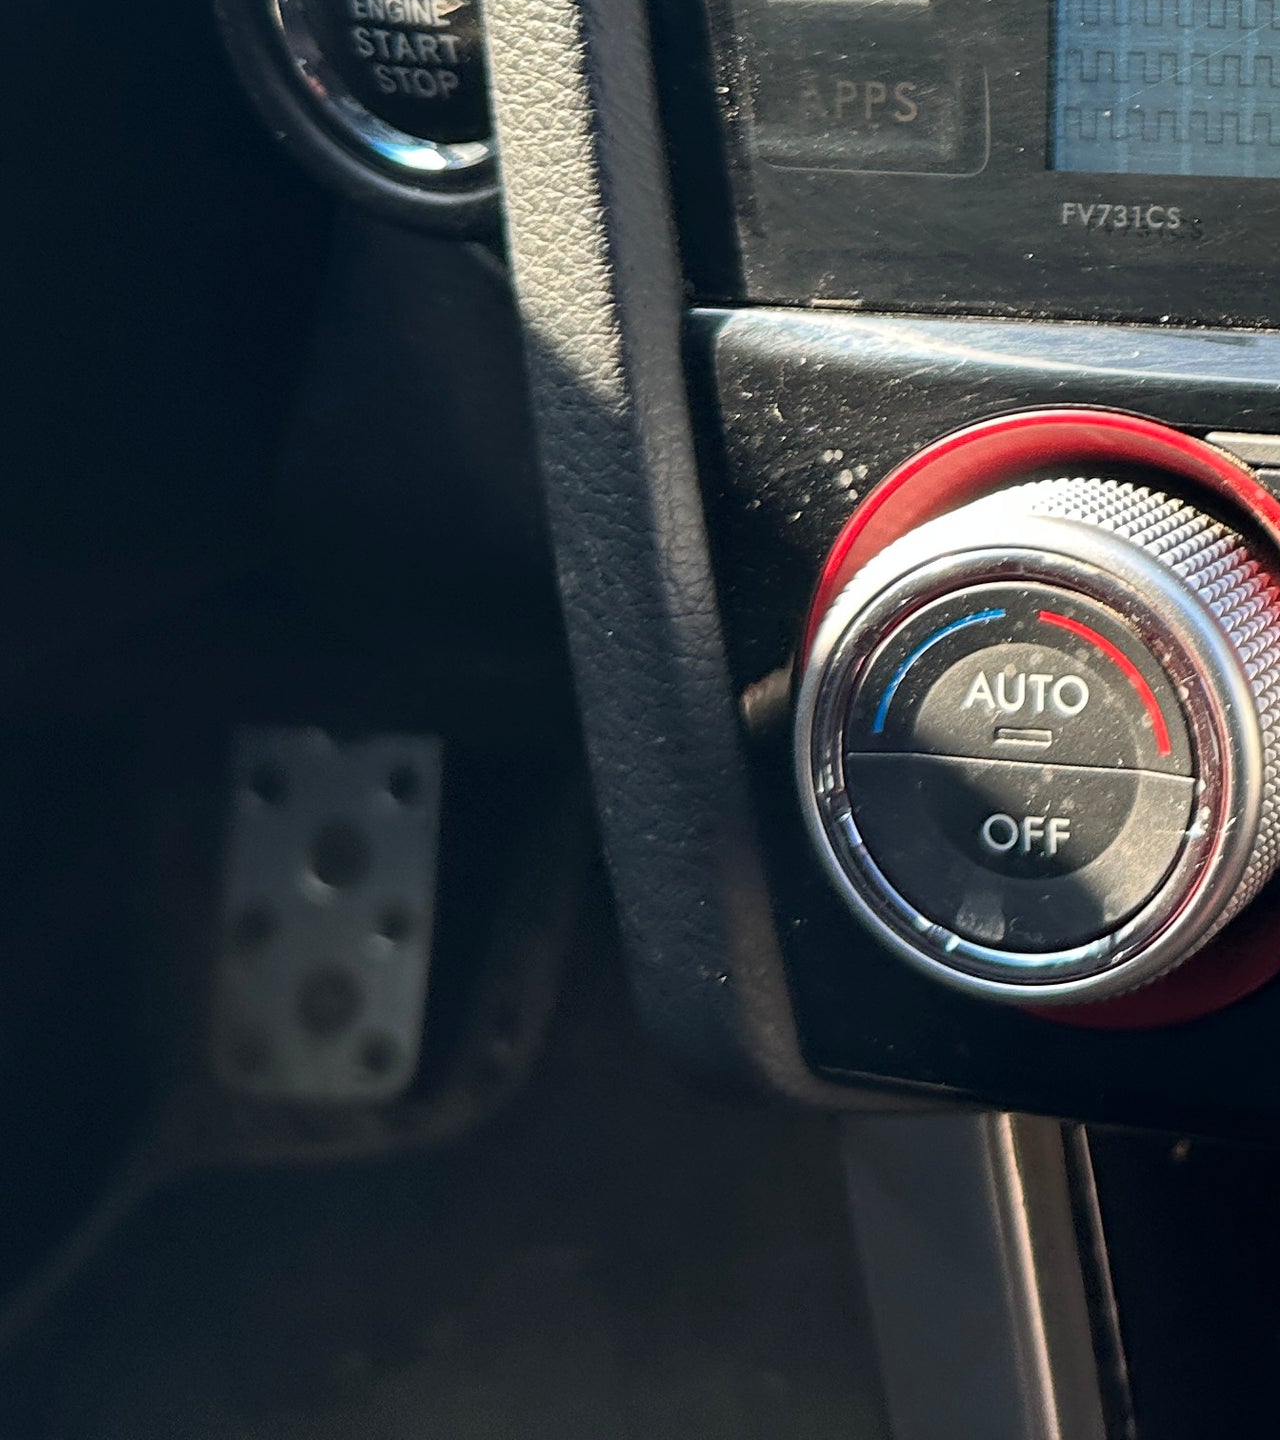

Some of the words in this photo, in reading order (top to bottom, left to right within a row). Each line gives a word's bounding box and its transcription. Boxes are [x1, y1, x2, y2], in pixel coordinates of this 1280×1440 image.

[353, 25, 460, 62] START
[374, 64, 459, 98] STOP
[1061, 203, 1183, 229] FV731CS
[962, 672, 1090, 716] AUTO
[982, 813, 1071, 854] OFF
